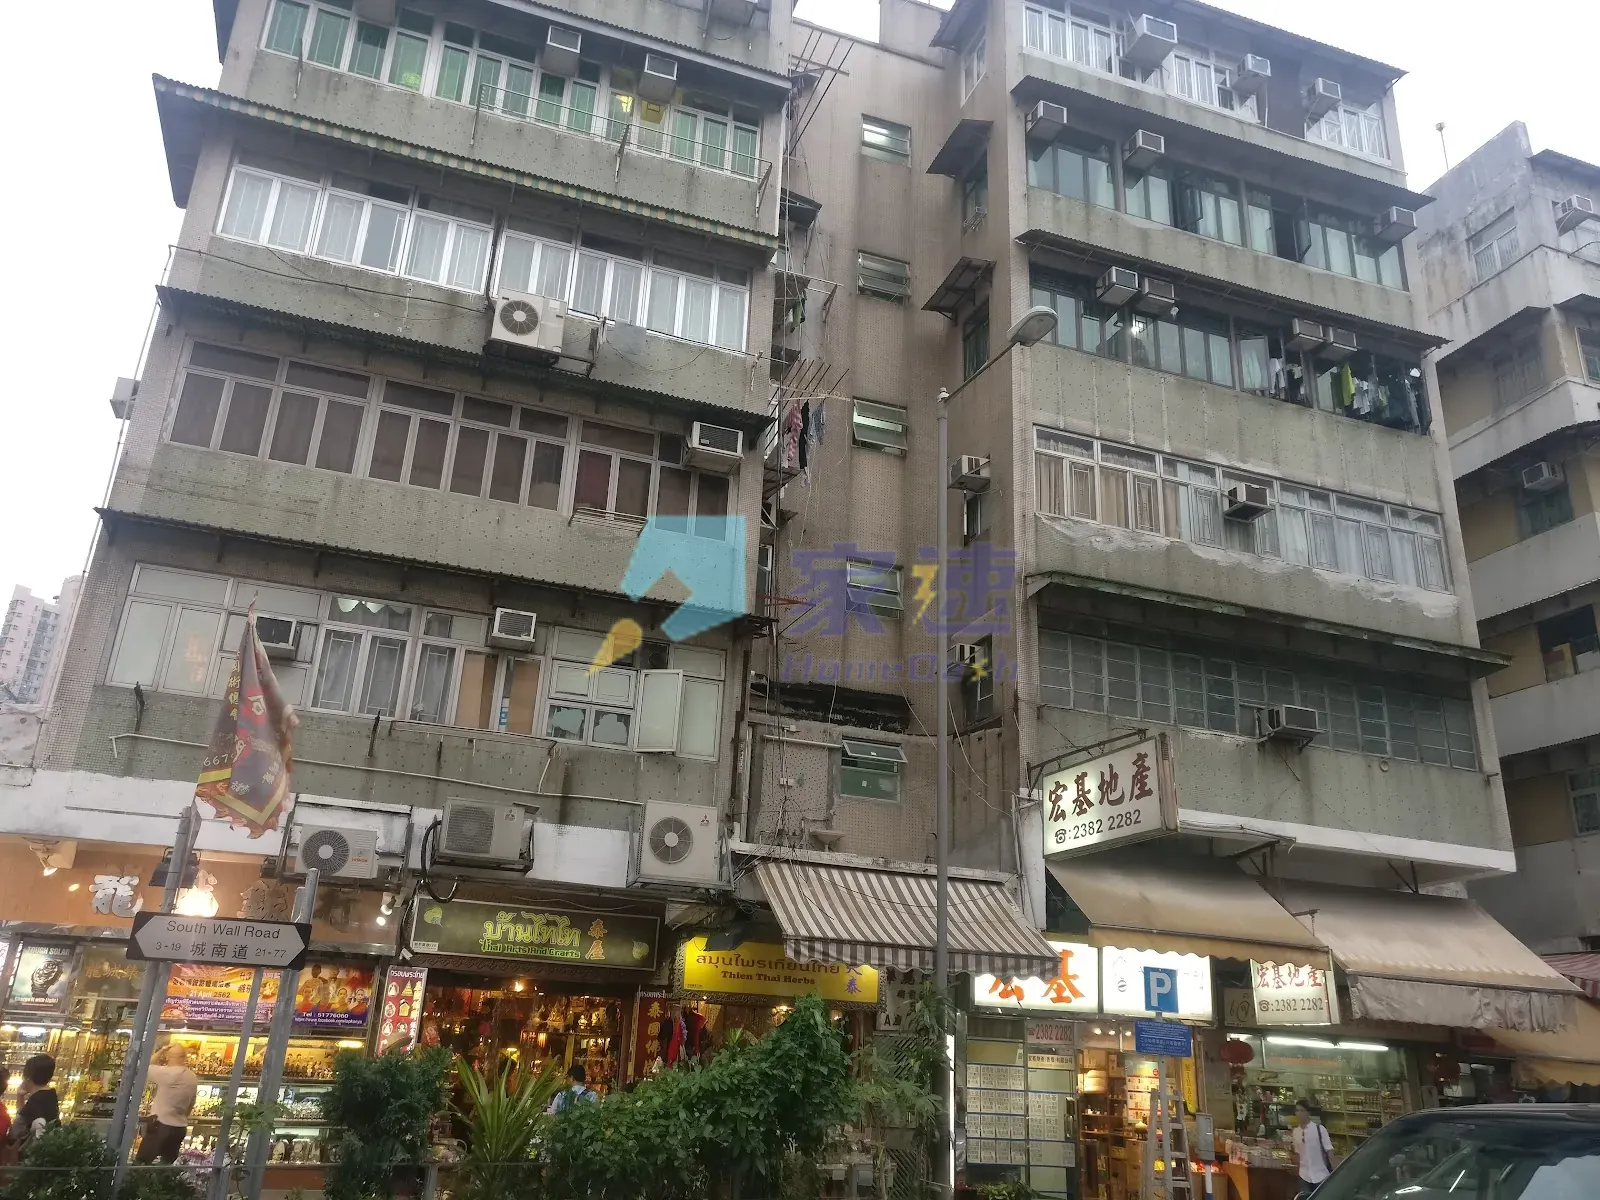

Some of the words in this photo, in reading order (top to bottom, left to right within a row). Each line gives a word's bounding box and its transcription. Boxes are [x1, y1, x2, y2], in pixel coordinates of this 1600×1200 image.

[1048, 751, 1154, 823] 宏基地產
[1107, 808, 1142, 832] 2282
[166, 920, 207, 935] South
[212, 923, 241, 937] Wall
[244, 925, 281, 939] Road
[585, 918, 608, 960] 泰屋
[49, 947, 71, 956] SOLAR
[189, 941, 249, 960] 城南道
[479, 938, 504, 953] Thai
[721, 970, 753, 980] Thien
[756, 972, 781, 983] Thai
[783, 975, 815, 985] Herbs
[1256, 964, 1323, 989] 宏基地產
[1149, 971, 1172, 1007] P
[1300, 997, 1324, 1011] 2282
[1035, 1023, 1054, 1041] 2382
[1054, 1024, 1073, 1042] 2282
